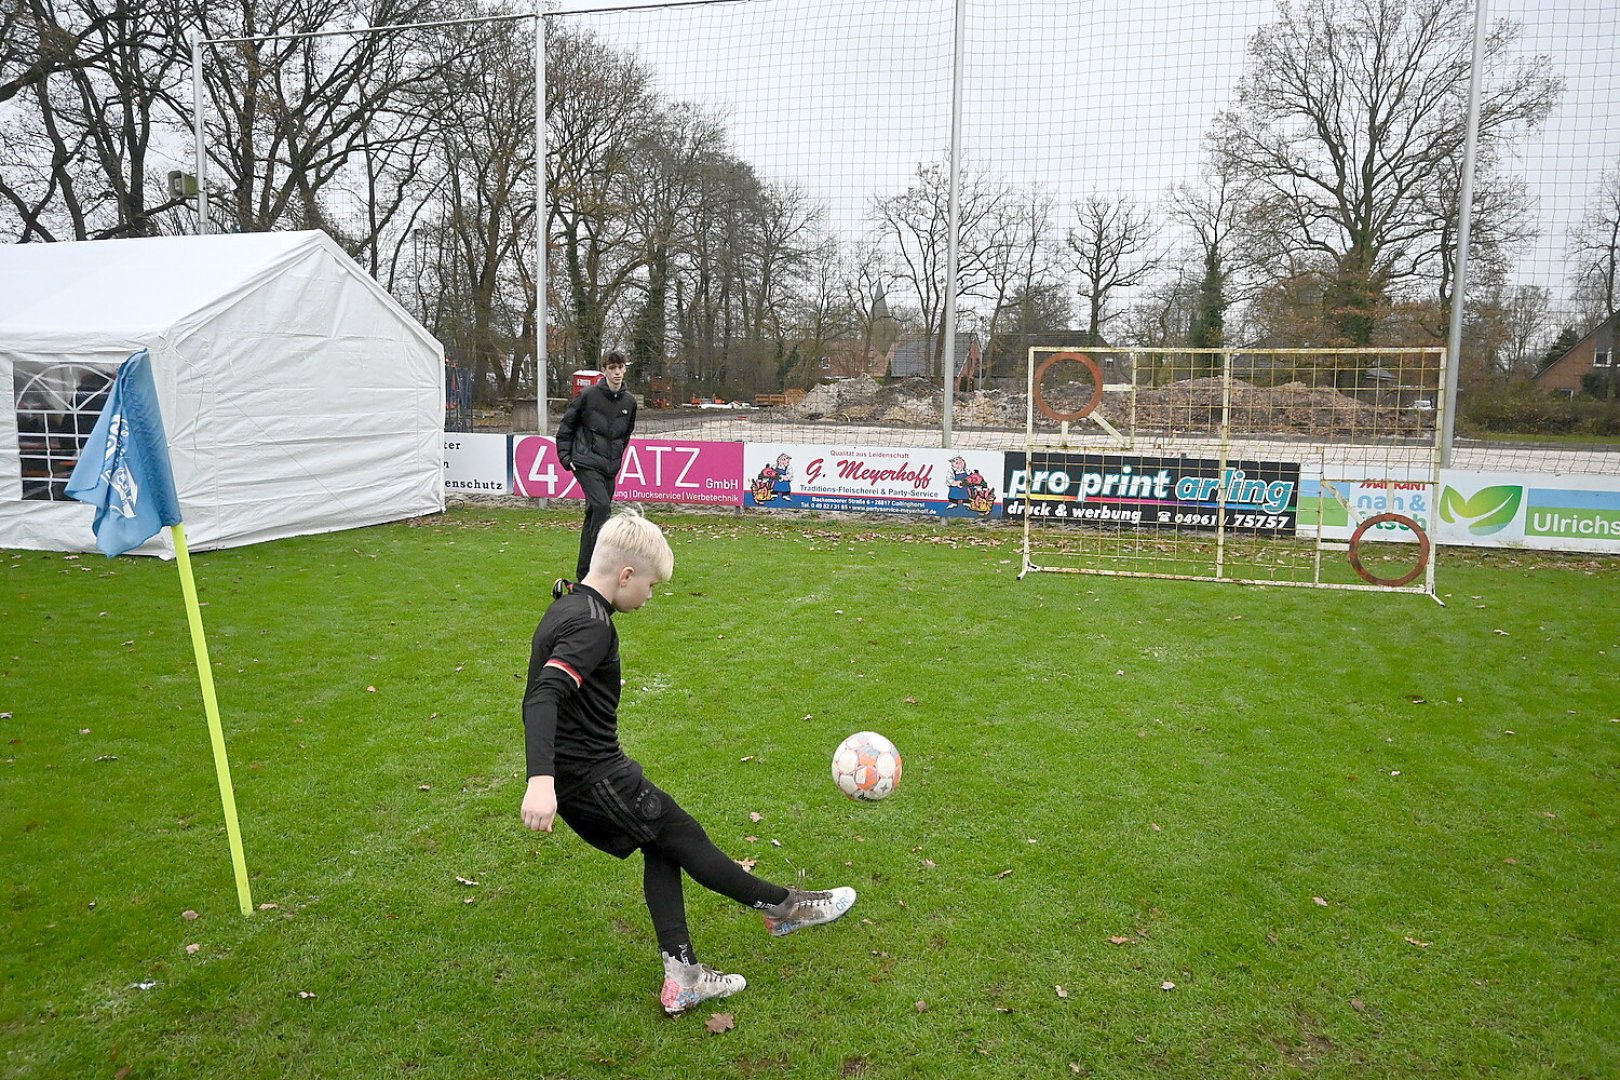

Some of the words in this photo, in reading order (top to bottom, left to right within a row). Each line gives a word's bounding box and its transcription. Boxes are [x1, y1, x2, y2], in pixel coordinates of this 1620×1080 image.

[830, 449, 856, 458] Qualität
[868, 451, 910, 459] Leidenschaft
[617, 445, 702, 488] ATZ
[705, 478, 739, 490] GmbH
[806, 458, 827, 484] G.
[836, 459, 934, 489] Meyerhoff
[632, 489, 681, 500] Druckservice
[686, 492, 739, 502] Werbetechnik
[800, 485, 879, 495] Traditions-Fleischerei
[888, 488, 939, 498] Party-Service
[1008, 468, 1071, 498] pro
[1077, 464, 1172, 501] print
[1175, 466, 1294, 515] arling
[1409, 494, 1426, 512] &
[1054, 504, 1068, 517] &
[1071, 505, 1142, 524] werbung
[1174, 513, 1218, 526] 04961
[1234, 514, 1290, 529] 75757
